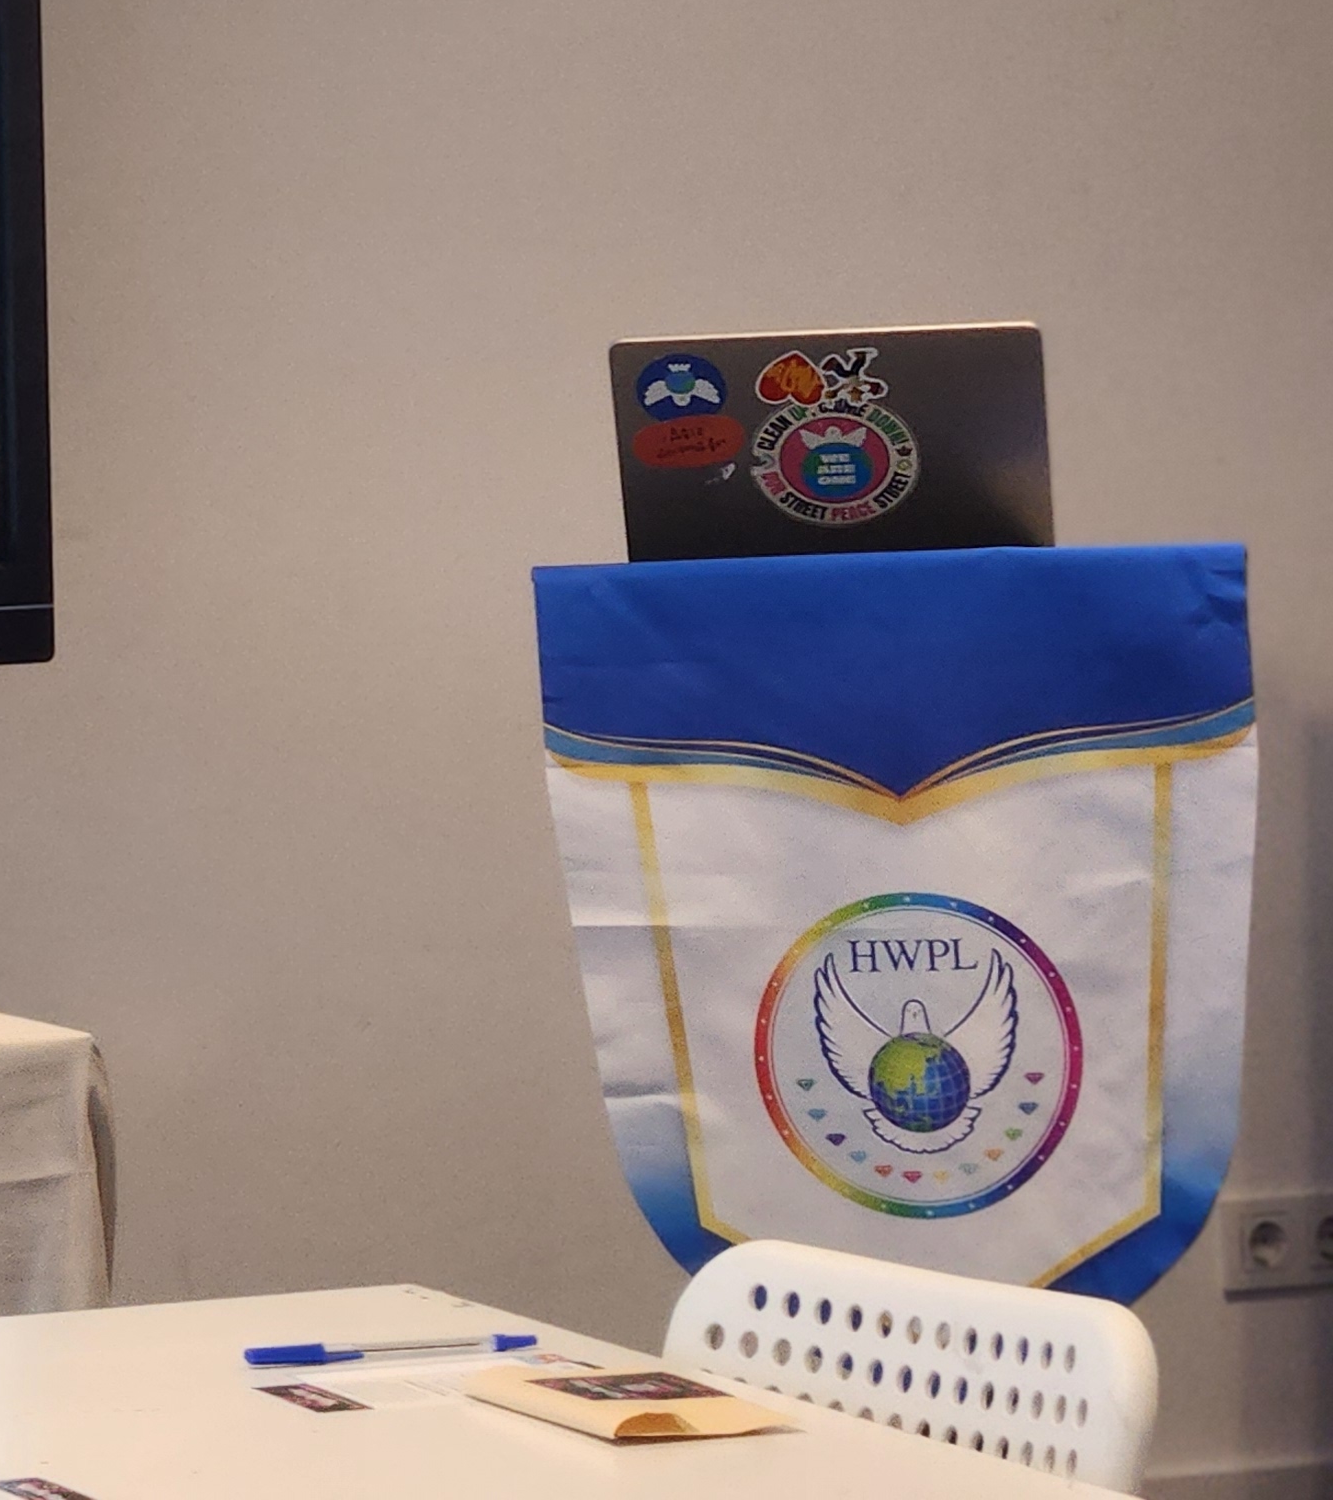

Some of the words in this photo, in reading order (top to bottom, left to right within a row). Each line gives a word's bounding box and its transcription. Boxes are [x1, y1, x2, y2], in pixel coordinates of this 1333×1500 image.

[757, 411, 793, 451] CLEAN
[780, 491, 829, 521] STREET
[830, 501, 877, 521] PEACE
[847, 938, 979, 973] HWPL
